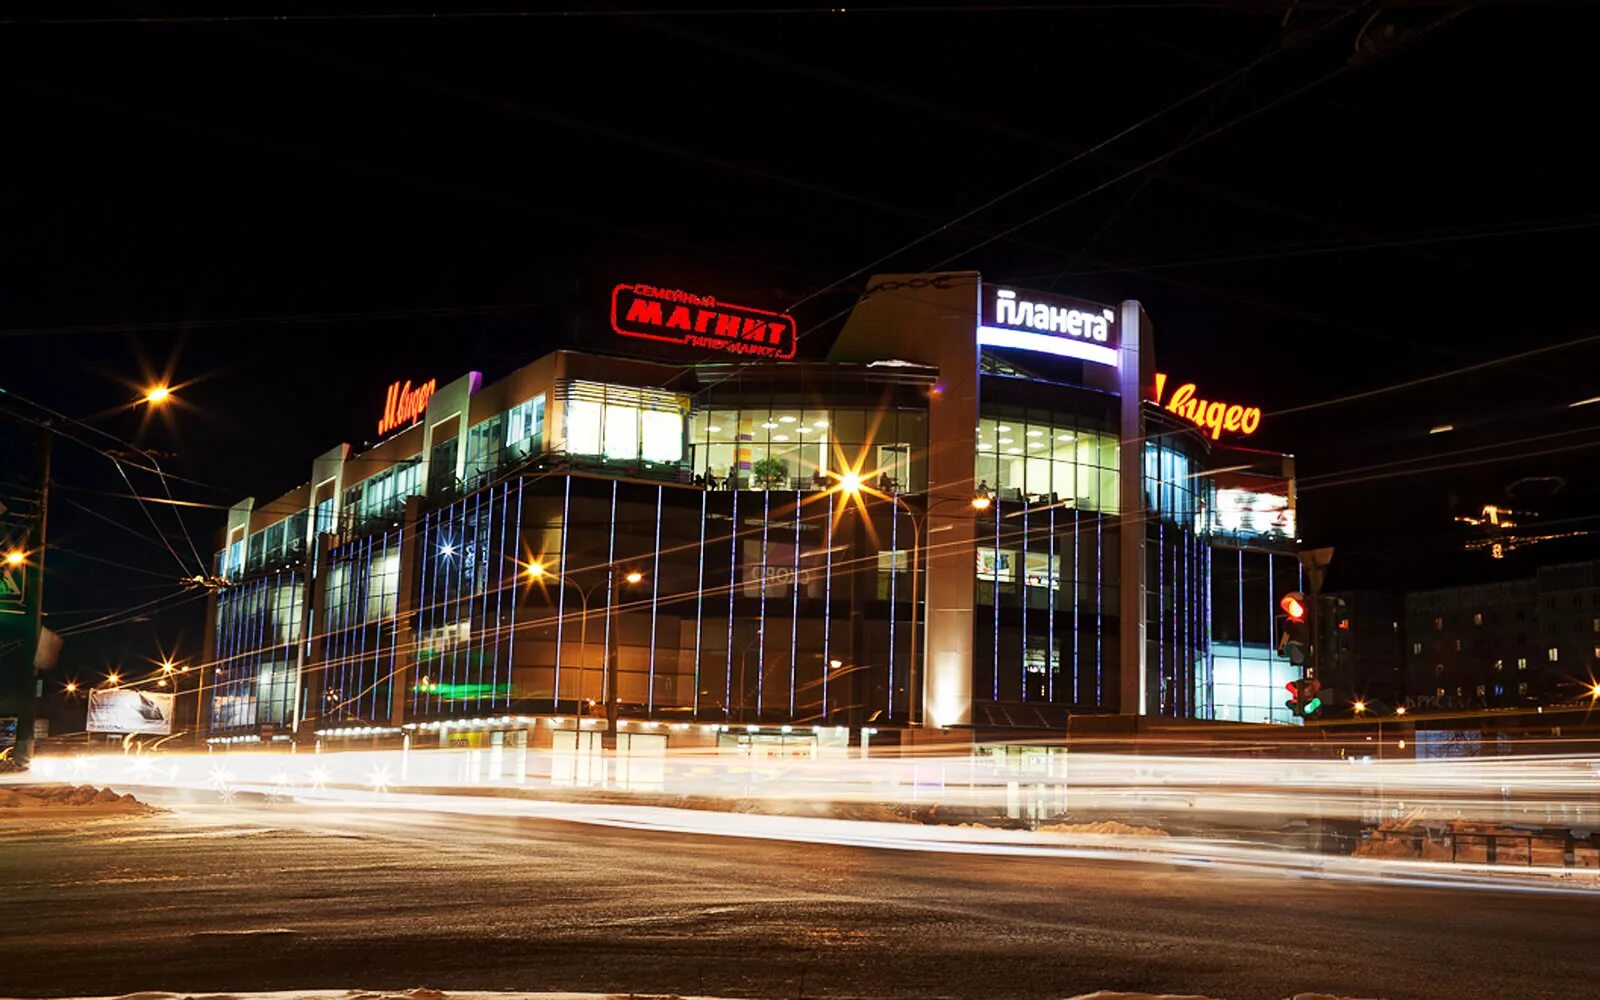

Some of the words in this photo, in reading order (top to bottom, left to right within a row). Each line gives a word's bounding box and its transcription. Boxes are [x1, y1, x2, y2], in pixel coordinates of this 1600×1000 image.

[633, 283, 716, 308] СЕМЕЙНЫЙ
[626, 297, 787, 345] МАГНИТ
[1154, 373, 1261, 440] видео
